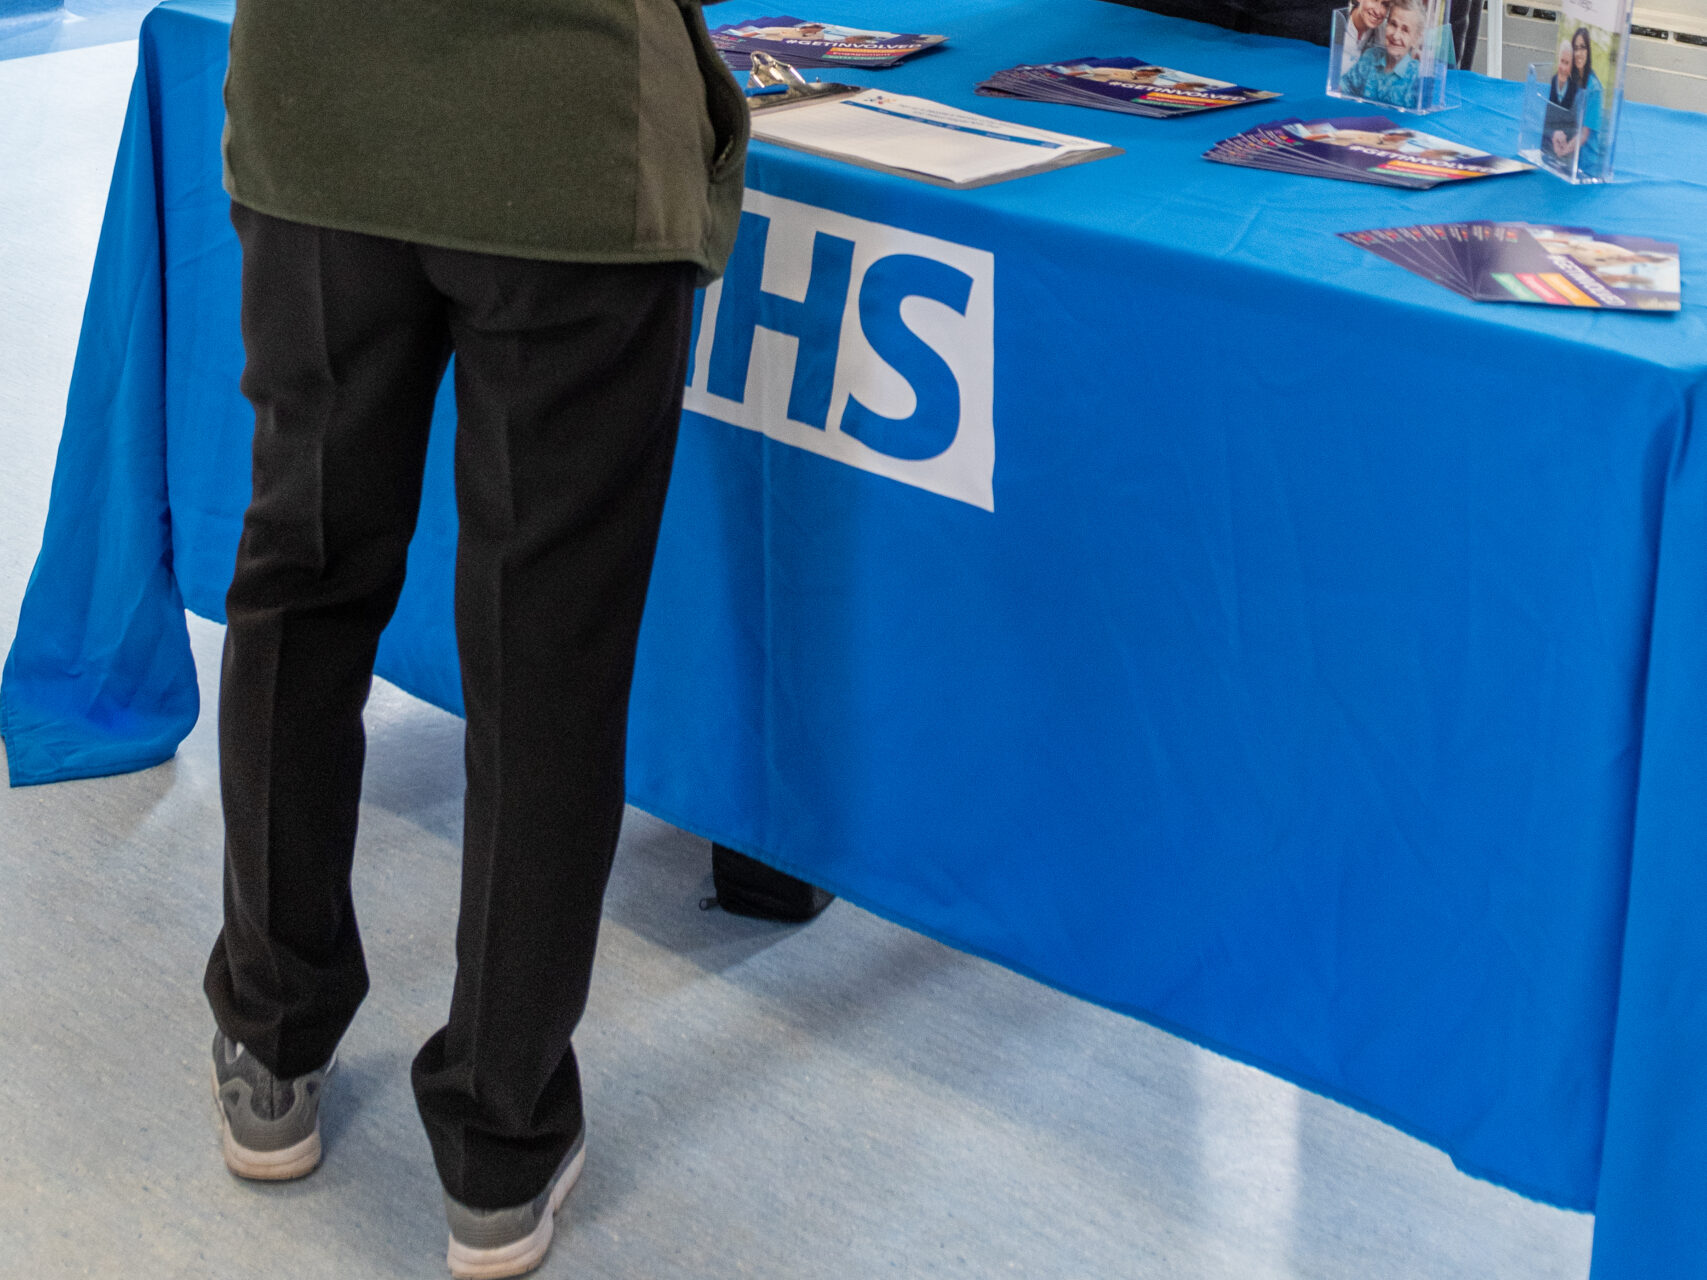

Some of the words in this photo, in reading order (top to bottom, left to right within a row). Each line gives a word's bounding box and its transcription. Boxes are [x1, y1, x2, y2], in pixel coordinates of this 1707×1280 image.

[785, 39, 922, 49] #GETINVOLVED
[1108, 81, 1247, 101] #GETINVOLVED
[685, 210, 974, 462] HS
